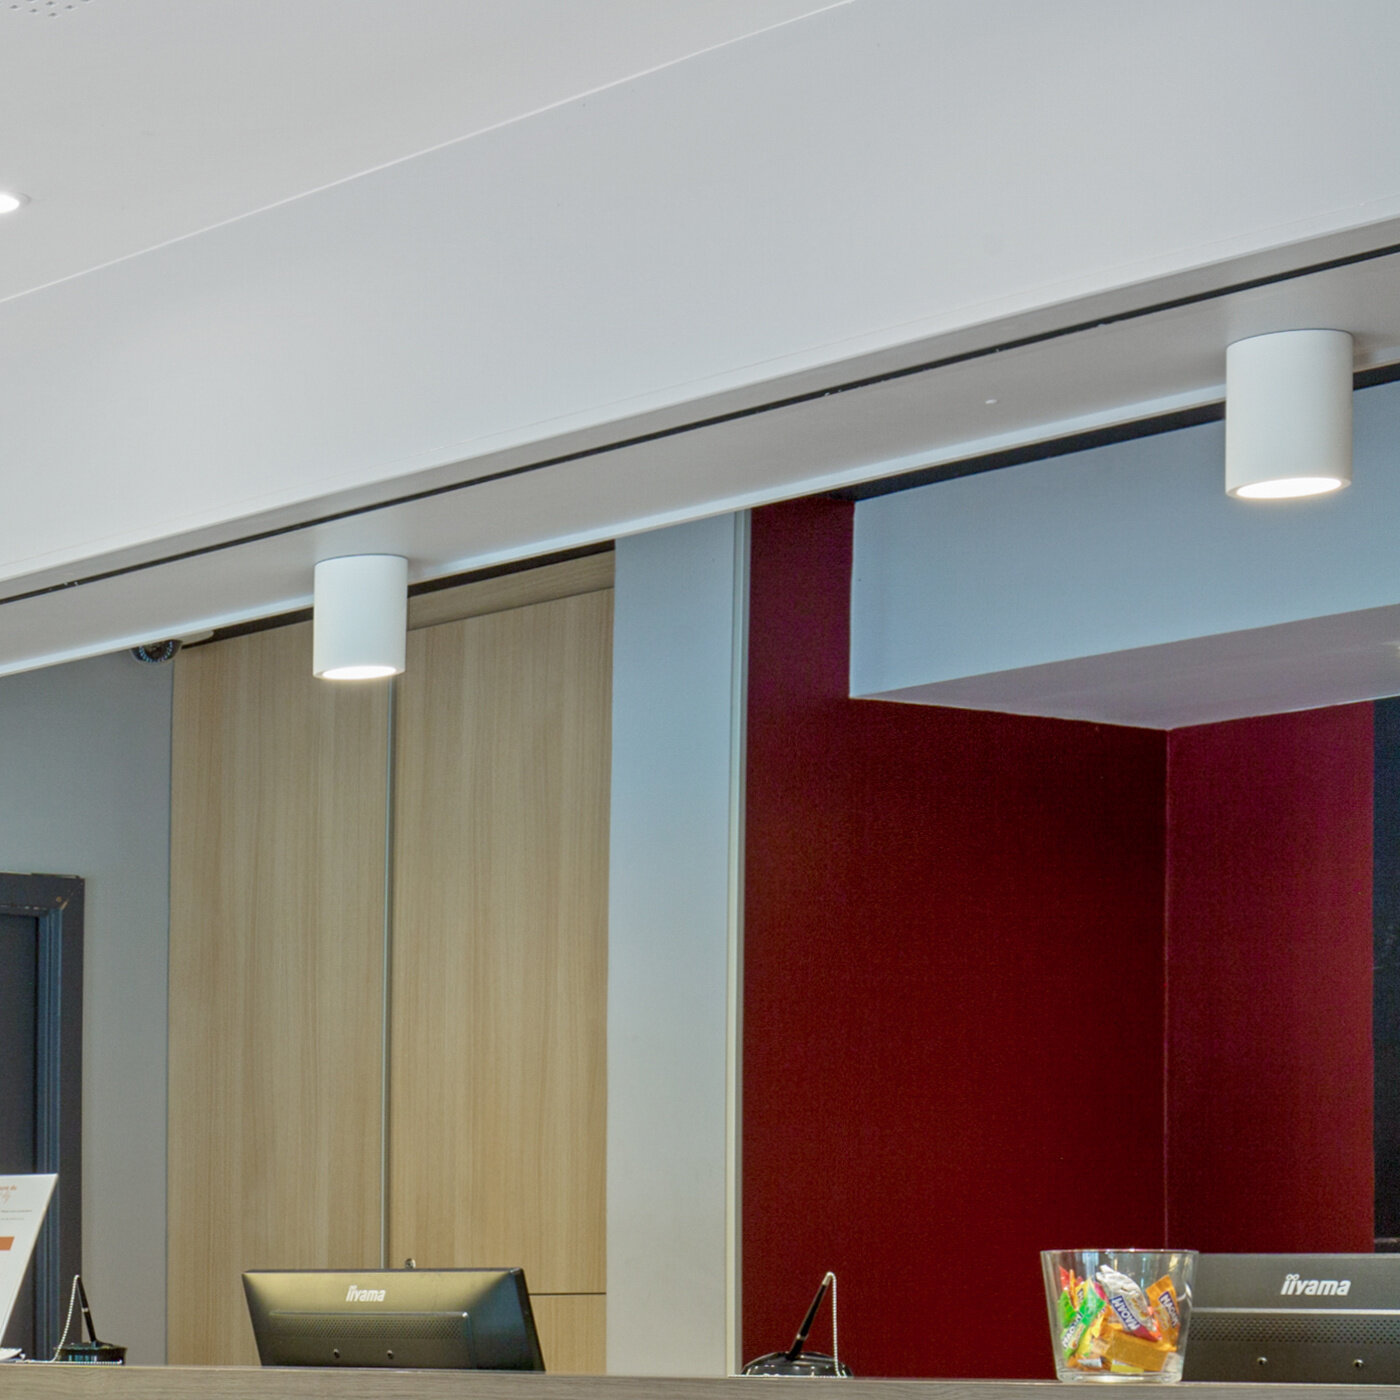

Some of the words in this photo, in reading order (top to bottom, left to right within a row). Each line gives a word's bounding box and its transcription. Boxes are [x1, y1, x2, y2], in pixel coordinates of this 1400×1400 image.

[345, 1284, 386, 1302] iiyama
[1280, 1273, 1352, 1296] iiyama
[1111, 1296, 1140, 1331] MAOAM
